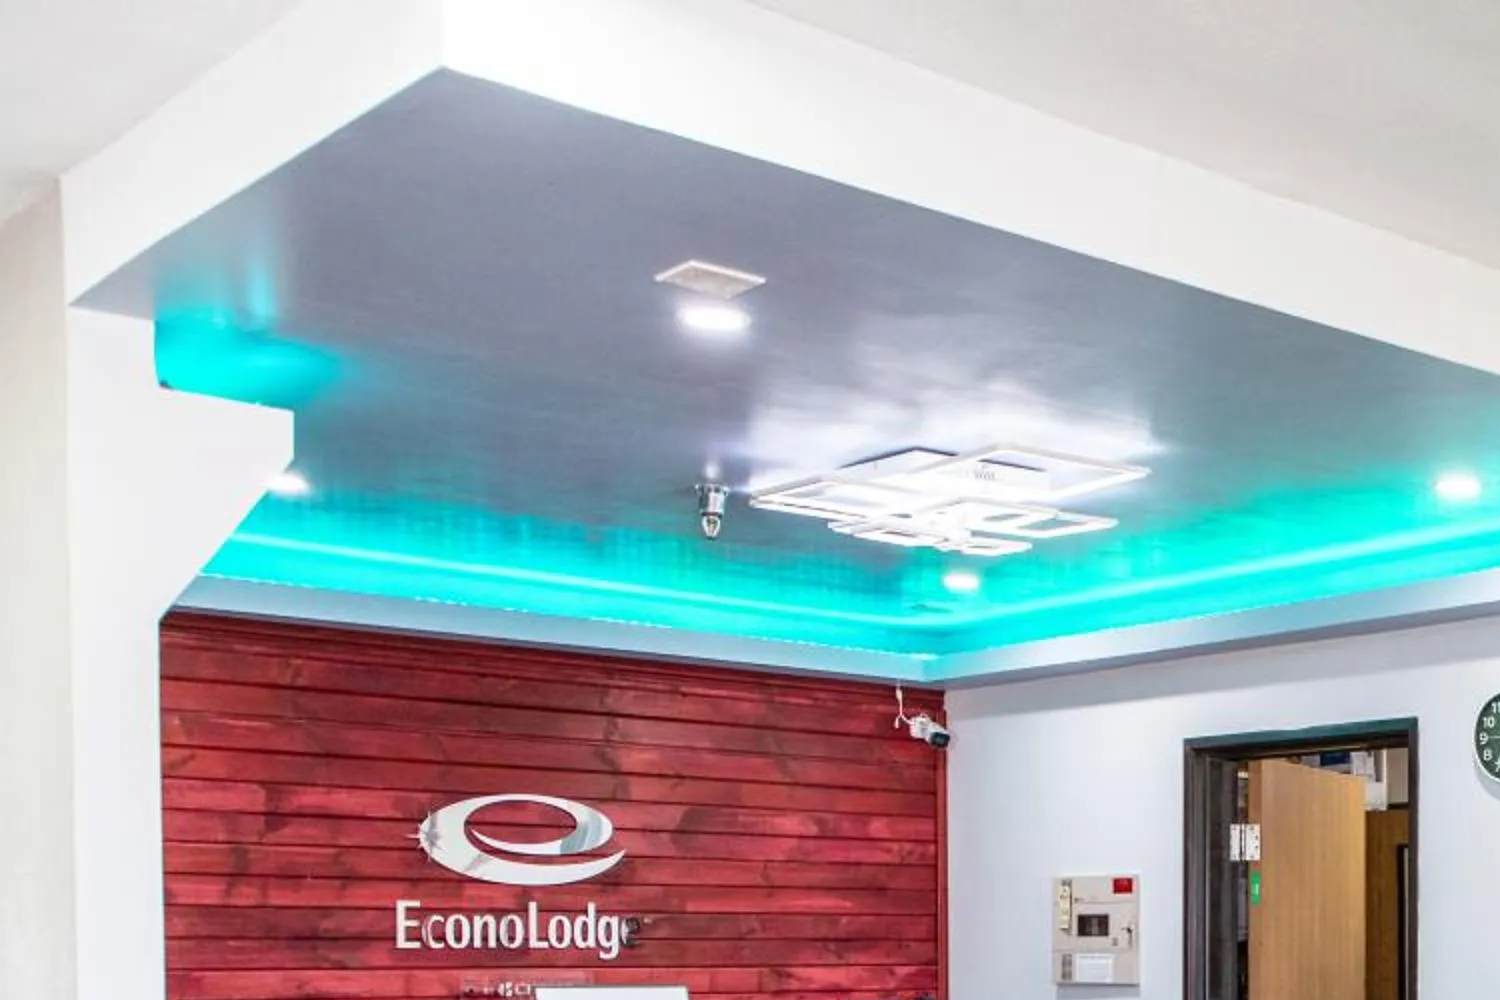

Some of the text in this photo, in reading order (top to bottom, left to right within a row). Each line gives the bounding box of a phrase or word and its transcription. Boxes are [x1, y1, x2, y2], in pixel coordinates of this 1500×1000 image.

[1483, 716, 1495, 728] 10
[1480, 732, 1489, 745] 9
[1483, 748, 1493, 761] 8
[395, 899, 631, 960] EconoLodg
